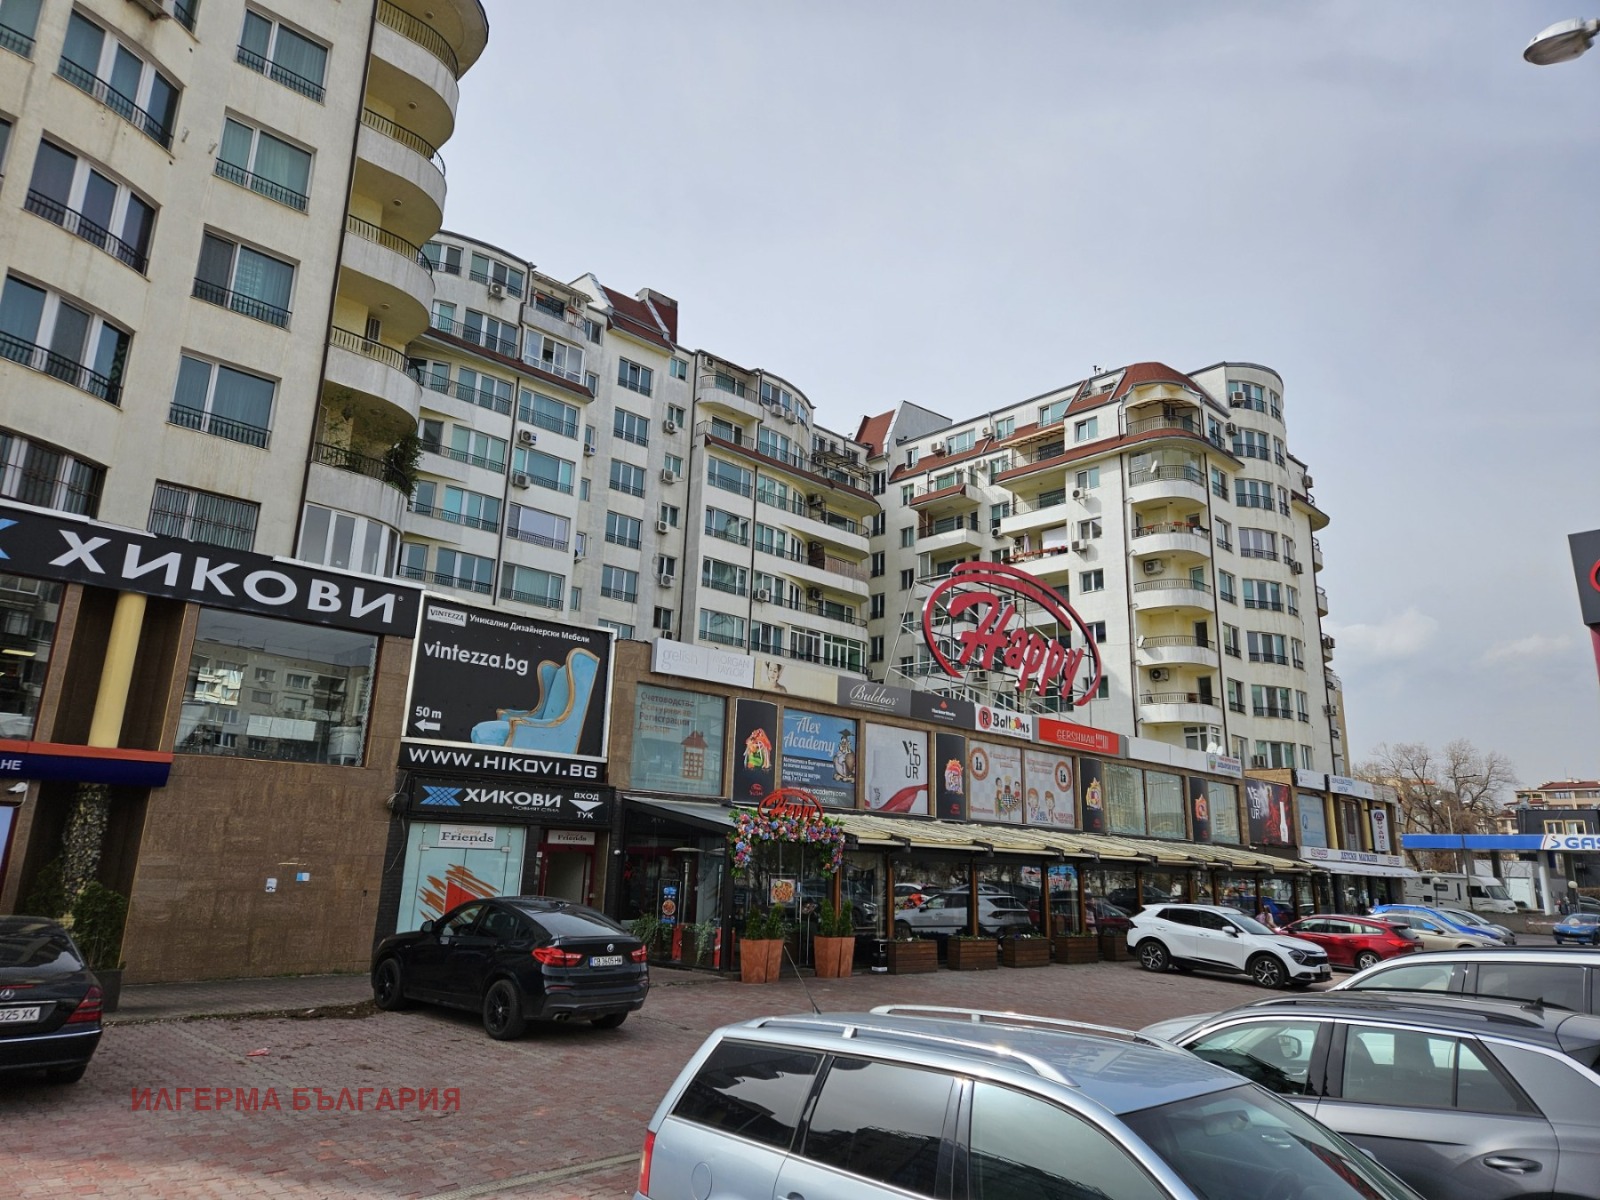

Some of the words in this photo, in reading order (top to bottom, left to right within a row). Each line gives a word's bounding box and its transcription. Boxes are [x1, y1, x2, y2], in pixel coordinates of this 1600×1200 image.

[49, 529, 397, 624] ХИКОВИ
[429, 608, 466, 622] VINTEZZA
[469, 614, 509, 629] Уникални
[509, 622, 560, 638] Дизайнерски
[561, 631, 590, 644] Мебели
[946, 591, 1085, 700] Happy
[424, 641, 529, 676] vintezza.bg
[849, 683, 897, 706] Buldoor
[415, 706, 430, 717] 50
[431, 710, 442, 719] m
[797, 717, 821, 734] Alex
[783, 732, 835, 758] Academy
[0, 759, 22, 770] HE
[409, 747, 598, 778] WWW.HIKOVI.BG
[463, 788, 561, 808] ХИКОВИ
[574, 792, 599, 801] ВХОД
[577, 811, 594, 819] ТУК
[440, 831, 494, 843] Friends
[557, 834, 587, 842] Friends
[1565, 837, 1600, 849] GA
[22, 1009, 37, 1019] XK
